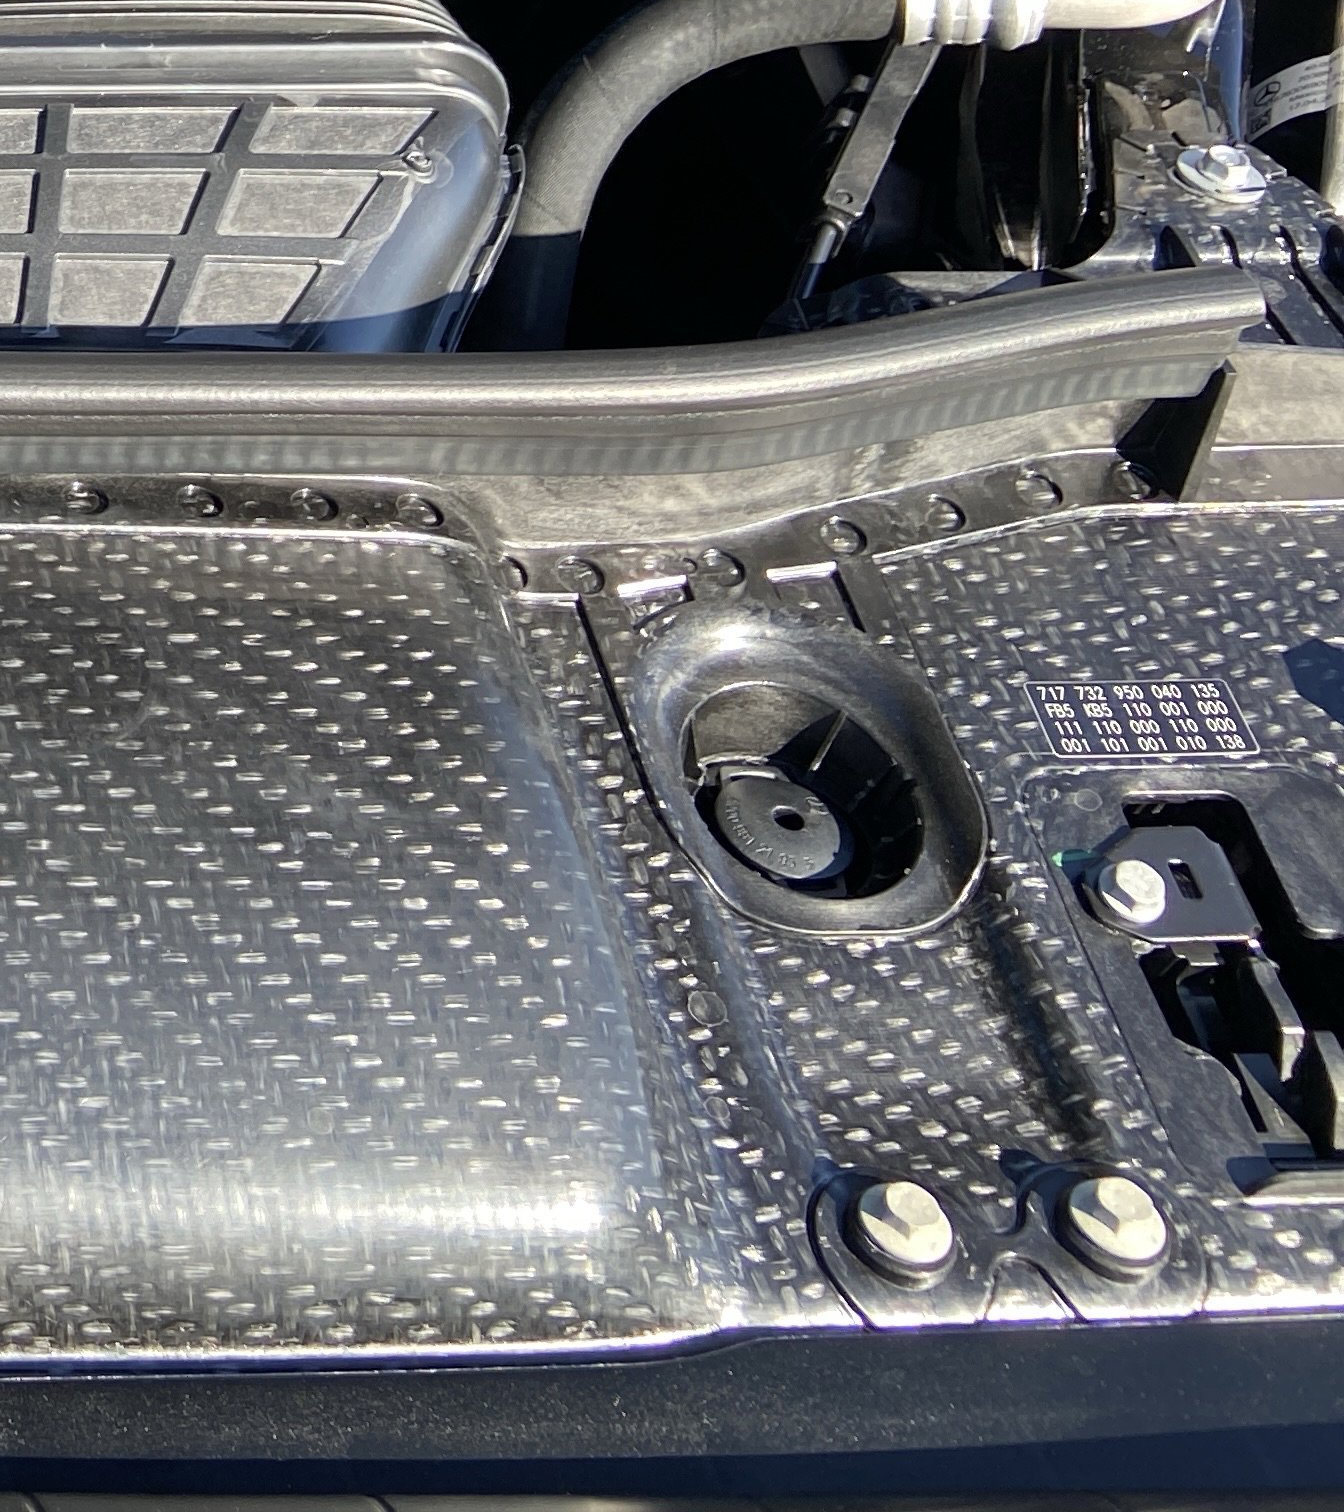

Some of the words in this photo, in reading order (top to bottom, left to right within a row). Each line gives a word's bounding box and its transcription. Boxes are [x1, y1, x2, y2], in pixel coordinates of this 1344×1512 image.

[1036, 686, 1065, 701] 717
[1073, 686, 1107, 701] 732
[1113, 685, 1144, 700] 950
[1151, 684, 1182, 699] 040
[1191, 683, 1220, 698] 135
[1044, 703, 1075, 719] FB5
[1082, 703, 1113, 718] KB5
[1123, 702, 1152, 717] 110
[1159, 701, 1190, 717] 001
[1197, 700, 1229, 715] 000
[1054, 721, 1083, 735] 111
[1092, 720, 1122, 735] 110
[1129, 719, 1161, 734] 000
[1169, 718, 1199, 733] 110
[1205, 717, 1237, 732] 000
[1061, 737, 1091, 753] 001
[1100, 737, 1130, 752] 101
[1137, 736, 1168, 751] 001
[1175, 735, 1207, 750] 010
[1215, 734, 1246, 749] 138
